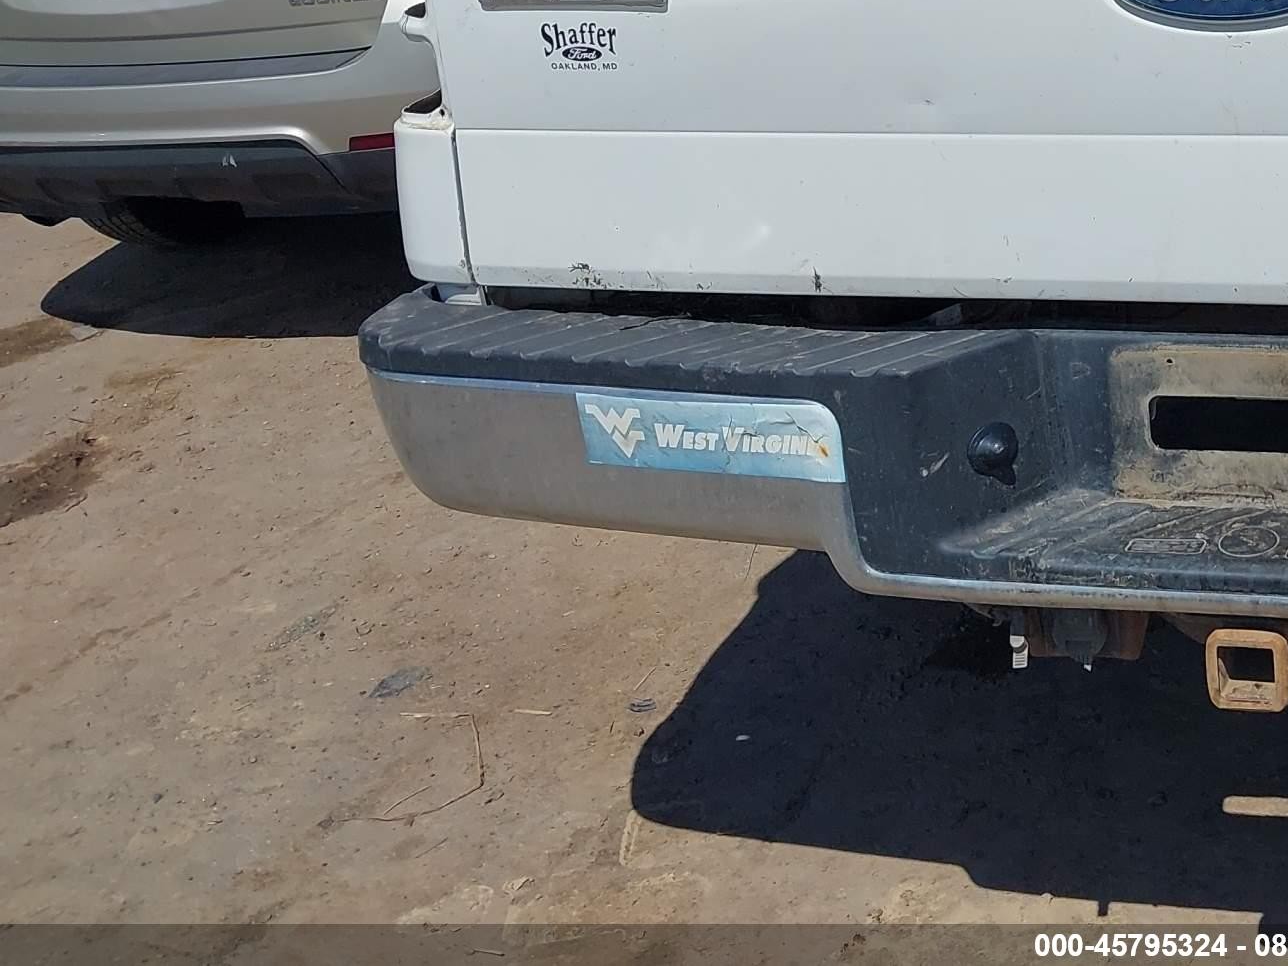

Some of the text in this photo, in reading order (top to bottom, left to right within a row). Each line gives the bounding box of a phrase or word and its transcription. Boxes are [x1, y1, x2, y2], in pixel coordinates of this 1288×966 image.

[541, 22, 617, 57] Shaffer
[567, 47, 598, 60] Ford
[551, 62, 618, 71] OAKLAND, MD
